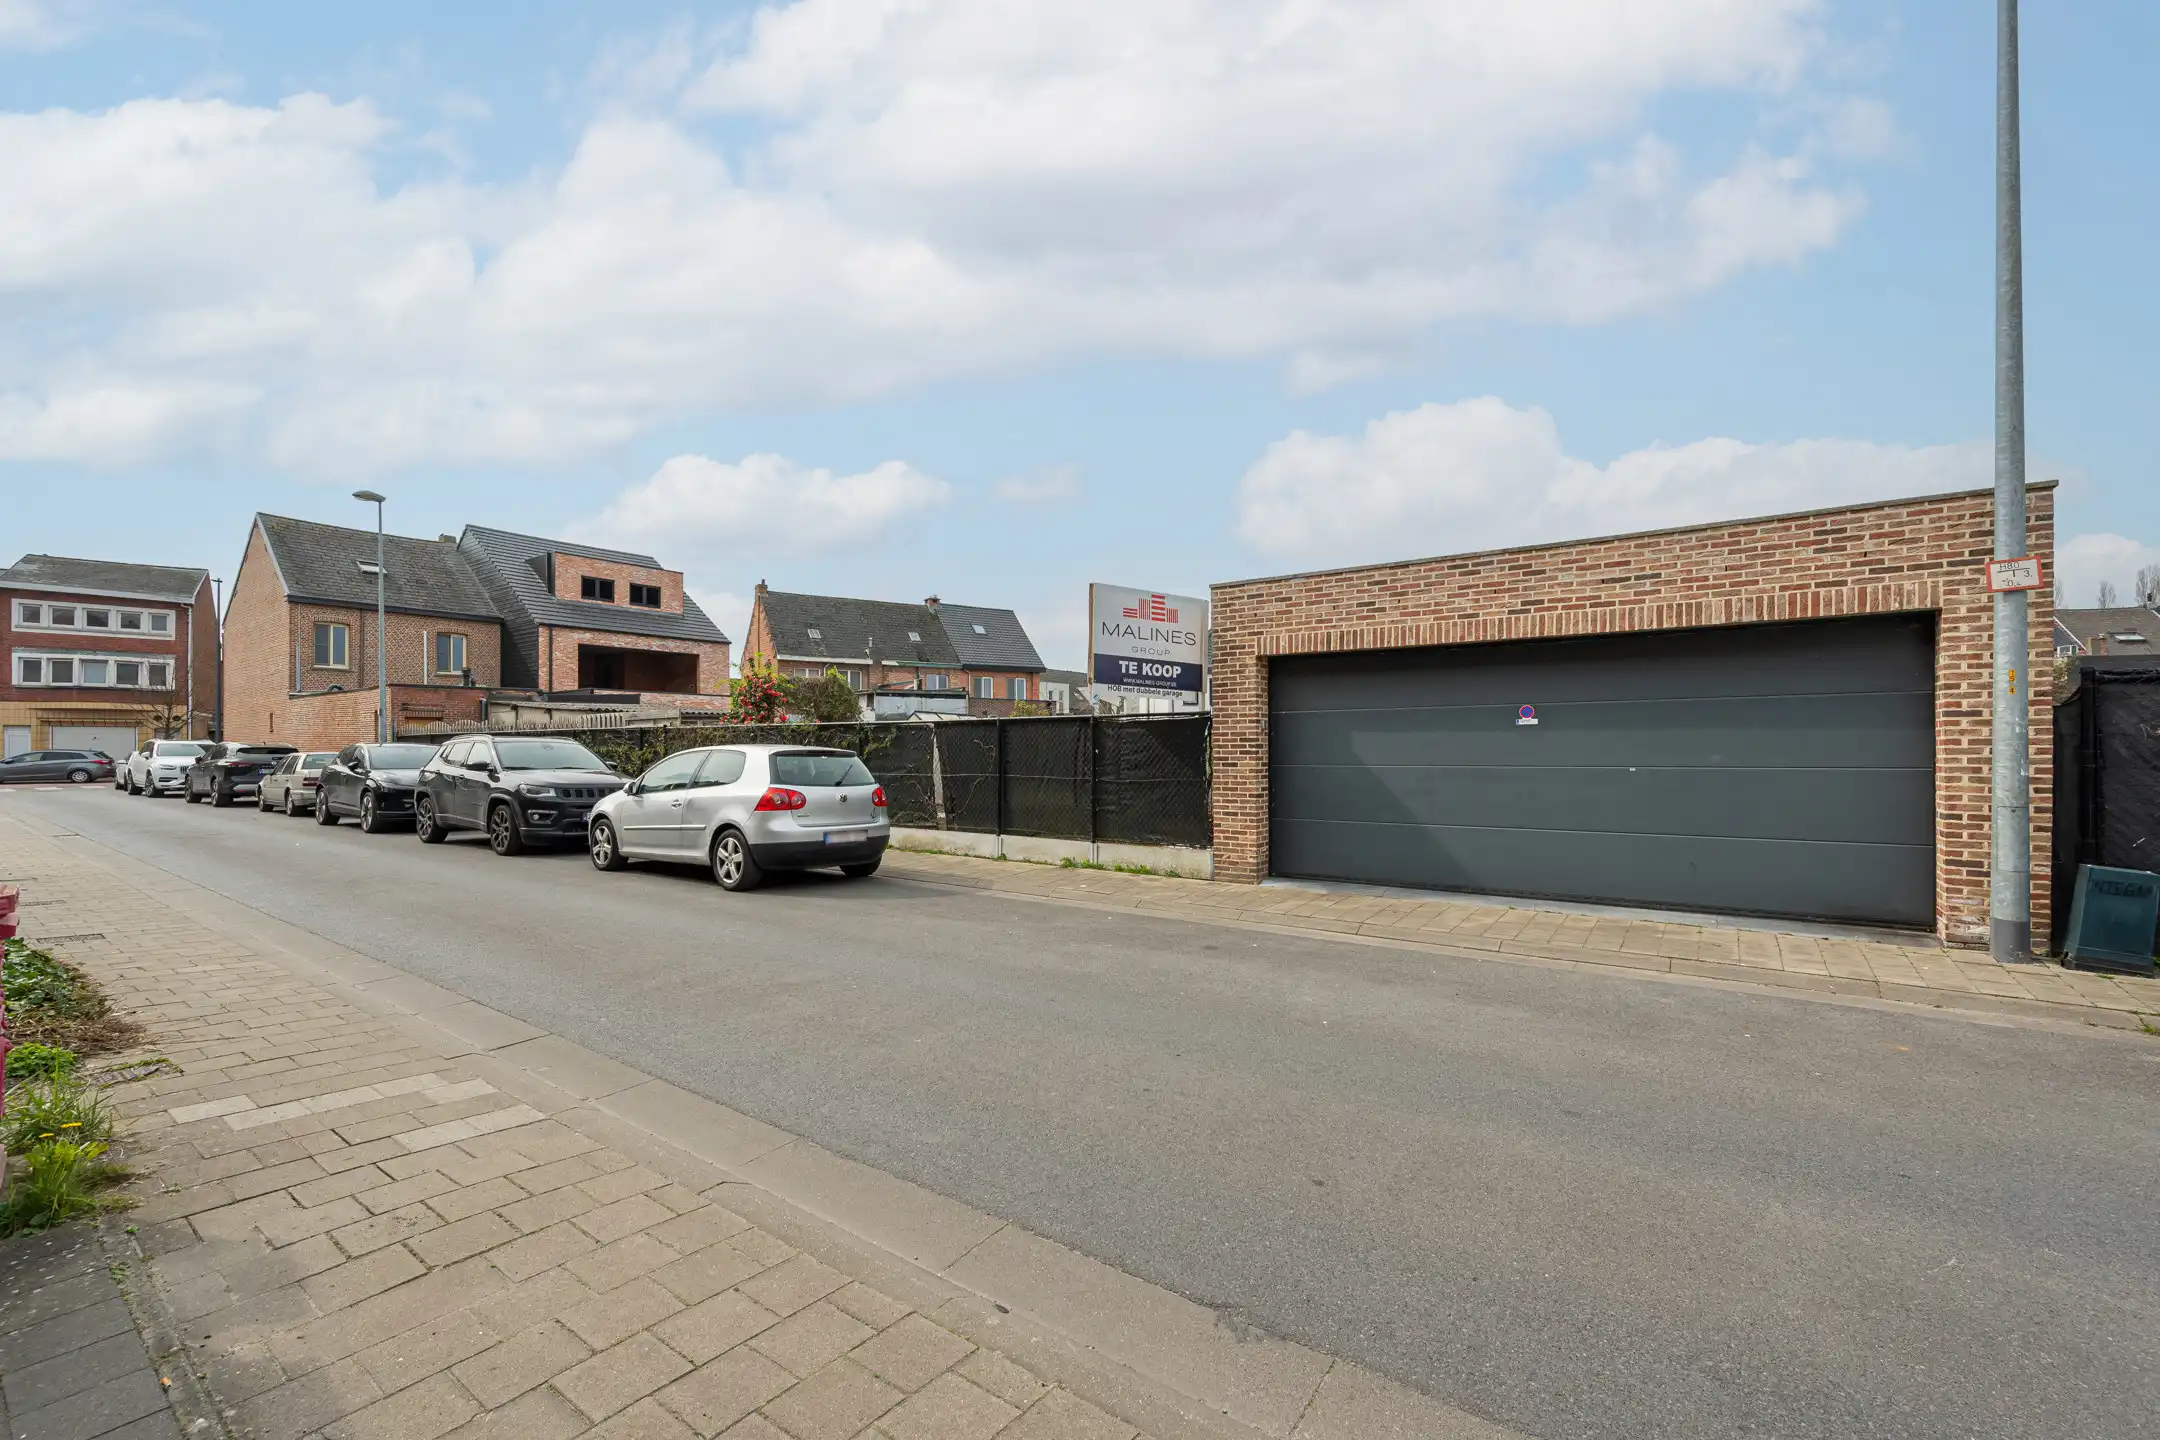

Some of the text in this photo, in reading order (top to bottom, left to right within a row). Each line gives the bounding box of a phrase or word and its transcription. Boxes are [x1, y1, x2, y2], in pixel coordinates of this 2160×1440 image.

[1102, 621, 1197, 646] MALINES
[1131, 646, 1171, 656] GROUP
[1118, 660, 1182, 678] TE KOOP
[1107, 684, 1122, 692] HOB
[1136, 686, 1161, 695] dubbele
[1162, 689, 1183, 698] garage
